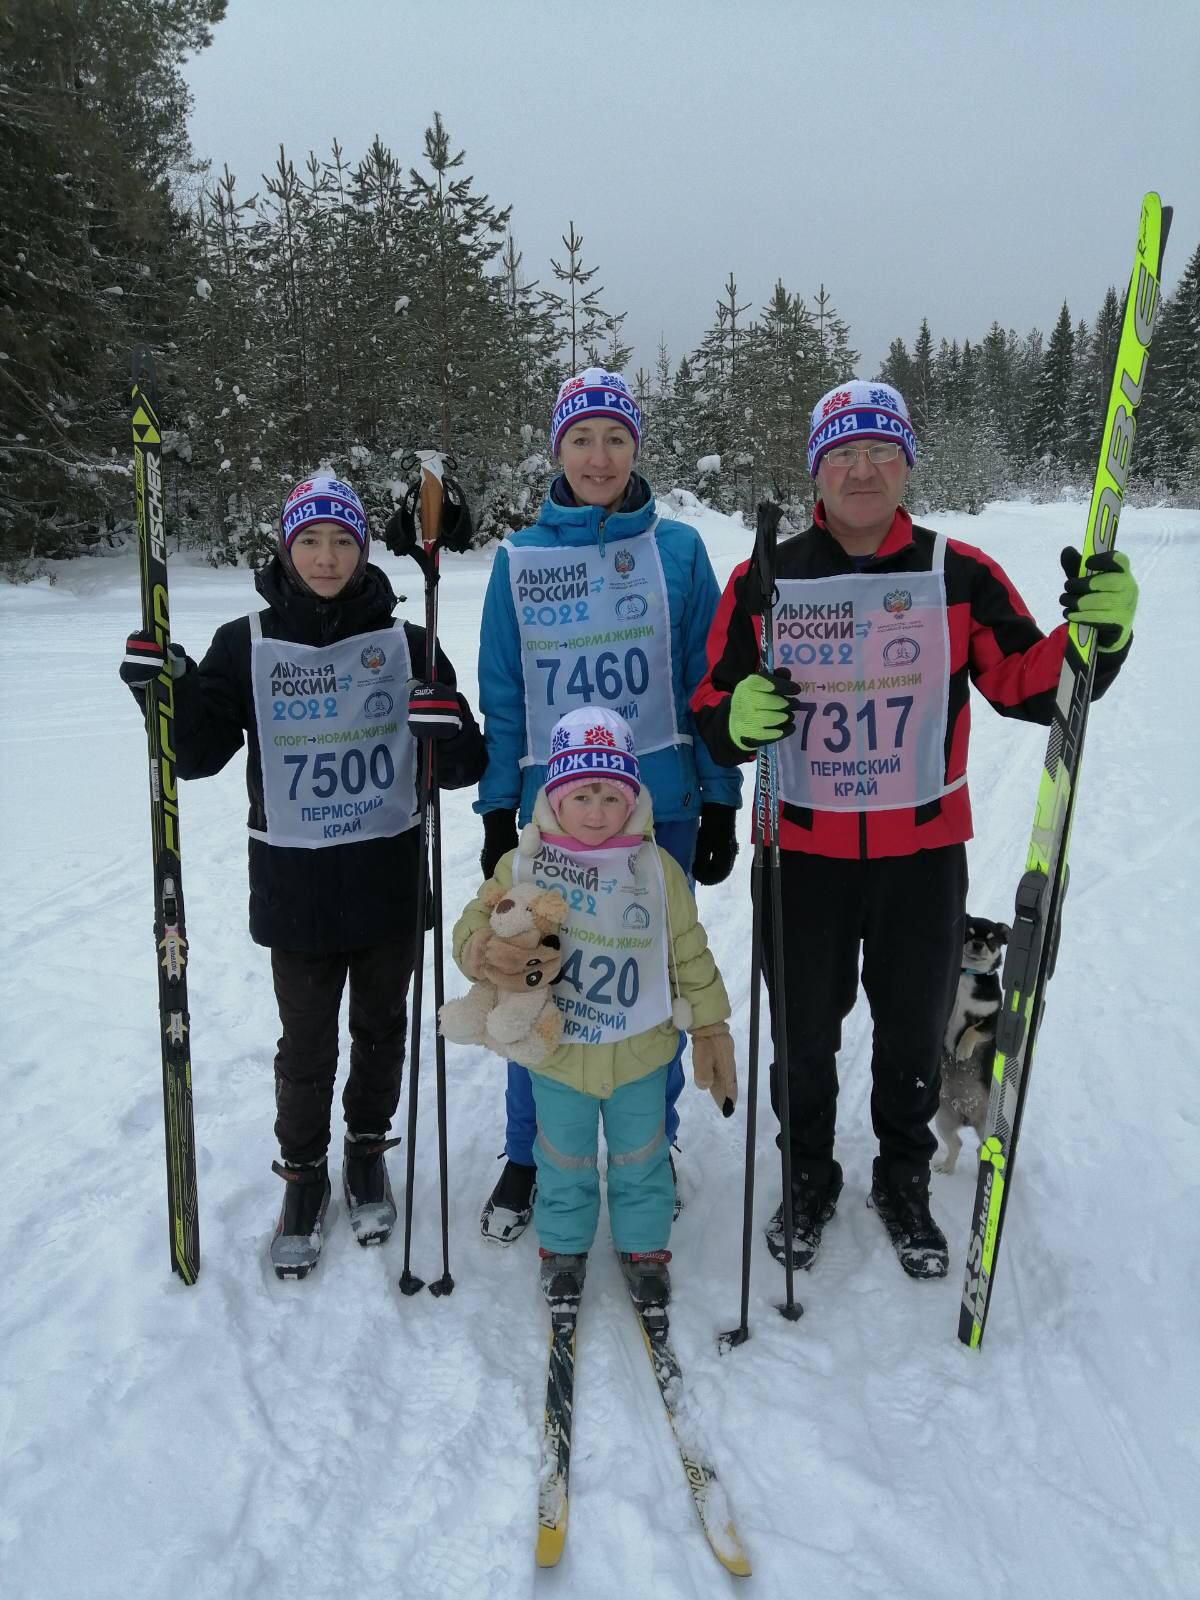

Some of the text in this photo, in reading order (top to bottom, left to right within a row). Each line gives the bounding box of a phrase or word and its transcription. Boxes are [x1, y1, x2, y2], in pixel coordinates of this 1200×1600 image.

[1077, 261, 1160, 648] ABLE
[146, 451, 165, 566] FISCHER
[515, 562, 588, 585] ЛЫЖНЯ
[518, 580, 590, 604] РОССИИ
[522, 600, 590, 627] 2022
[776, 600, 854, 621] ЛЫЖНЯ
[526, 638, 560, 652] СПОРТ
[568, 631, 611, 650] НОРМА
[777, 620, 854, 640] РОССИИ
[779, 643, 854, 665] 2022
[271, 676, 338, 697] РОССИИ
[535, 646, 650, 706] 7460
[827, 679, 877, 693] НОРМА
[878, 672, 923, 690] ЖИЗНИ
[272, 697, 339, 721] 2022
[798, 695, 914, 754] 7317
[273, 734, 308, 747] СПОРТ
[317, 729, 361, 744] НОРМА
[283, 743, 395, 801] 7500
[811, 754, 901, 777] ПЕРМСКИЙ
[834, 777, 878, 797] КРАЙ
[301, 795, 384, 822] ПЕРМСКИЙ
[323, 817, 362, 839] КРАЙ
[569, 927, 614, 947] НОРМА
[563, 1019, 602, 1045] КРАЙ
[962, 1229, 983, 1316] RS
[979, 1172, 993, 1238] skate
